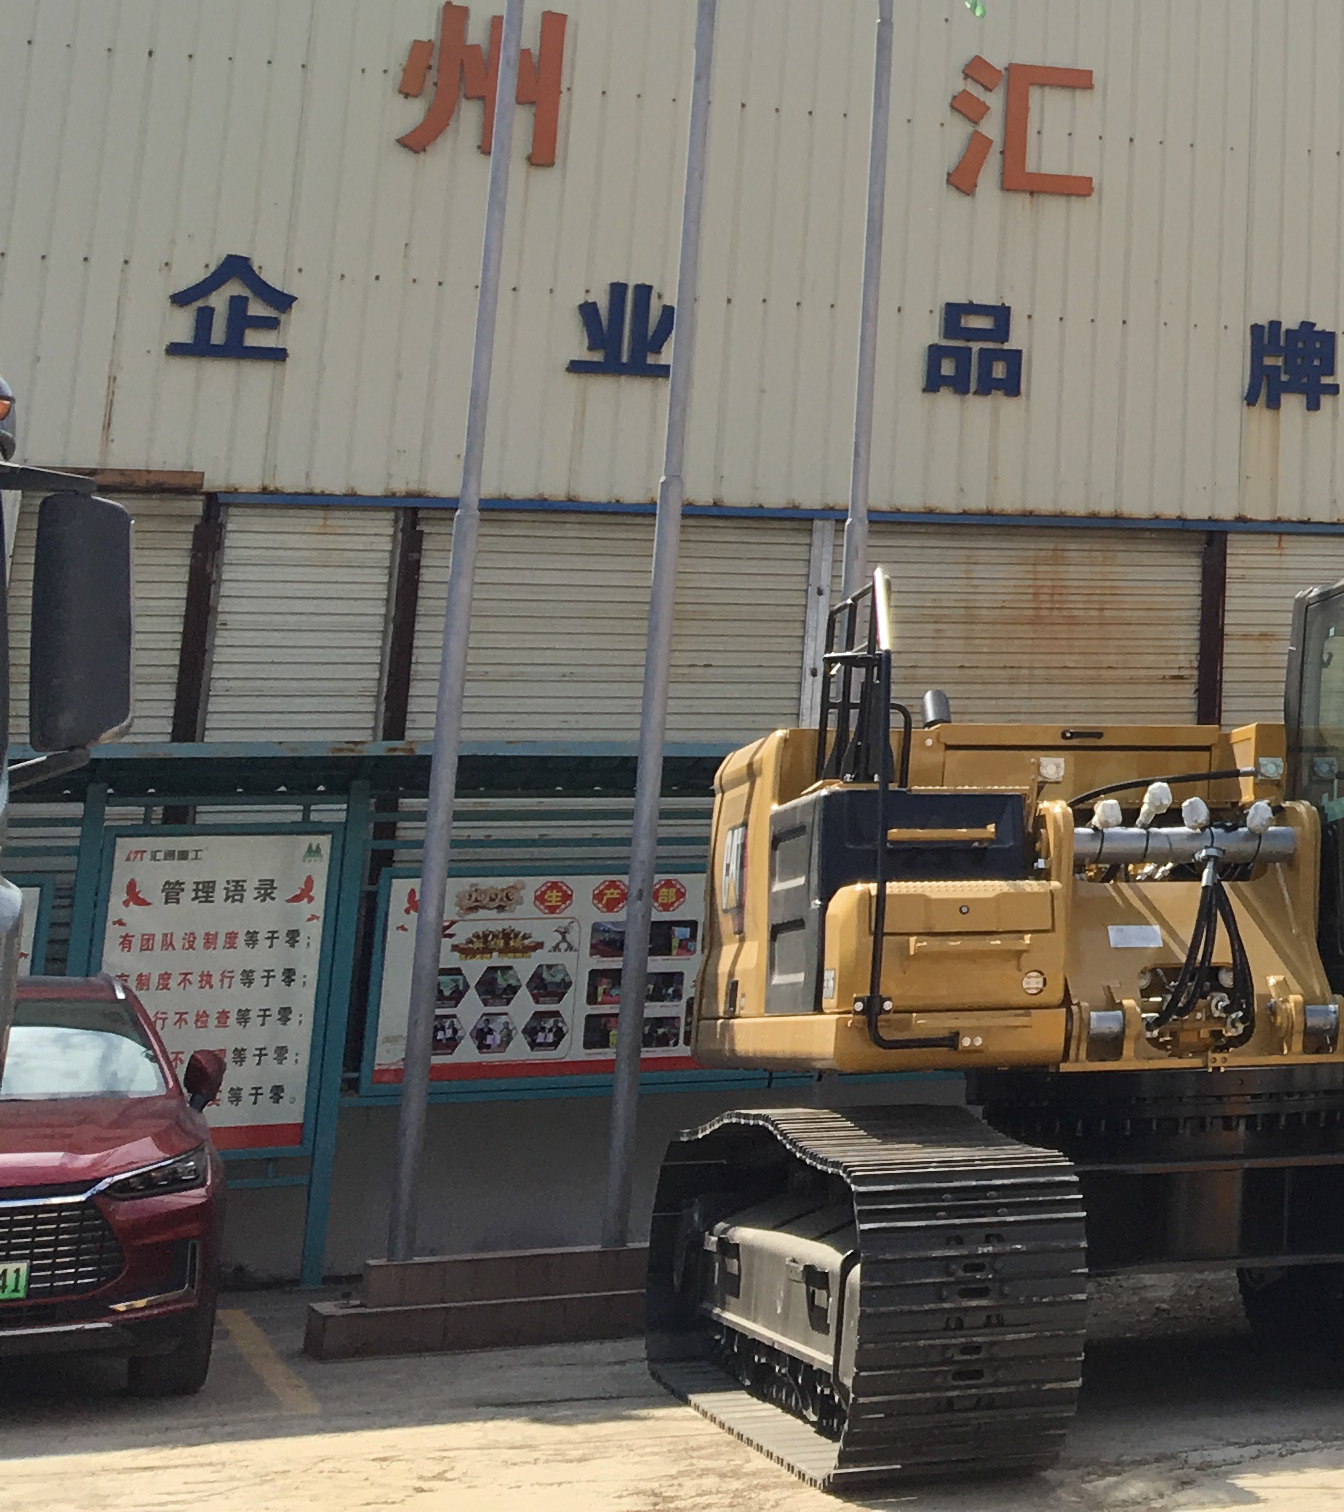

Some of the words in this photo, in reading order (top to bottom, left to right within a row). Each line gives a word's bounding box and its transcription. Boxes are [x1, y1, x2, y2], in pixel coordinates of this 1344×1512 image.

[722, 826, 746, 910] CAT
[161, 879, 278, 905] 管理语录
[152, 1006, 303, 1031] 行不检查等于零；
